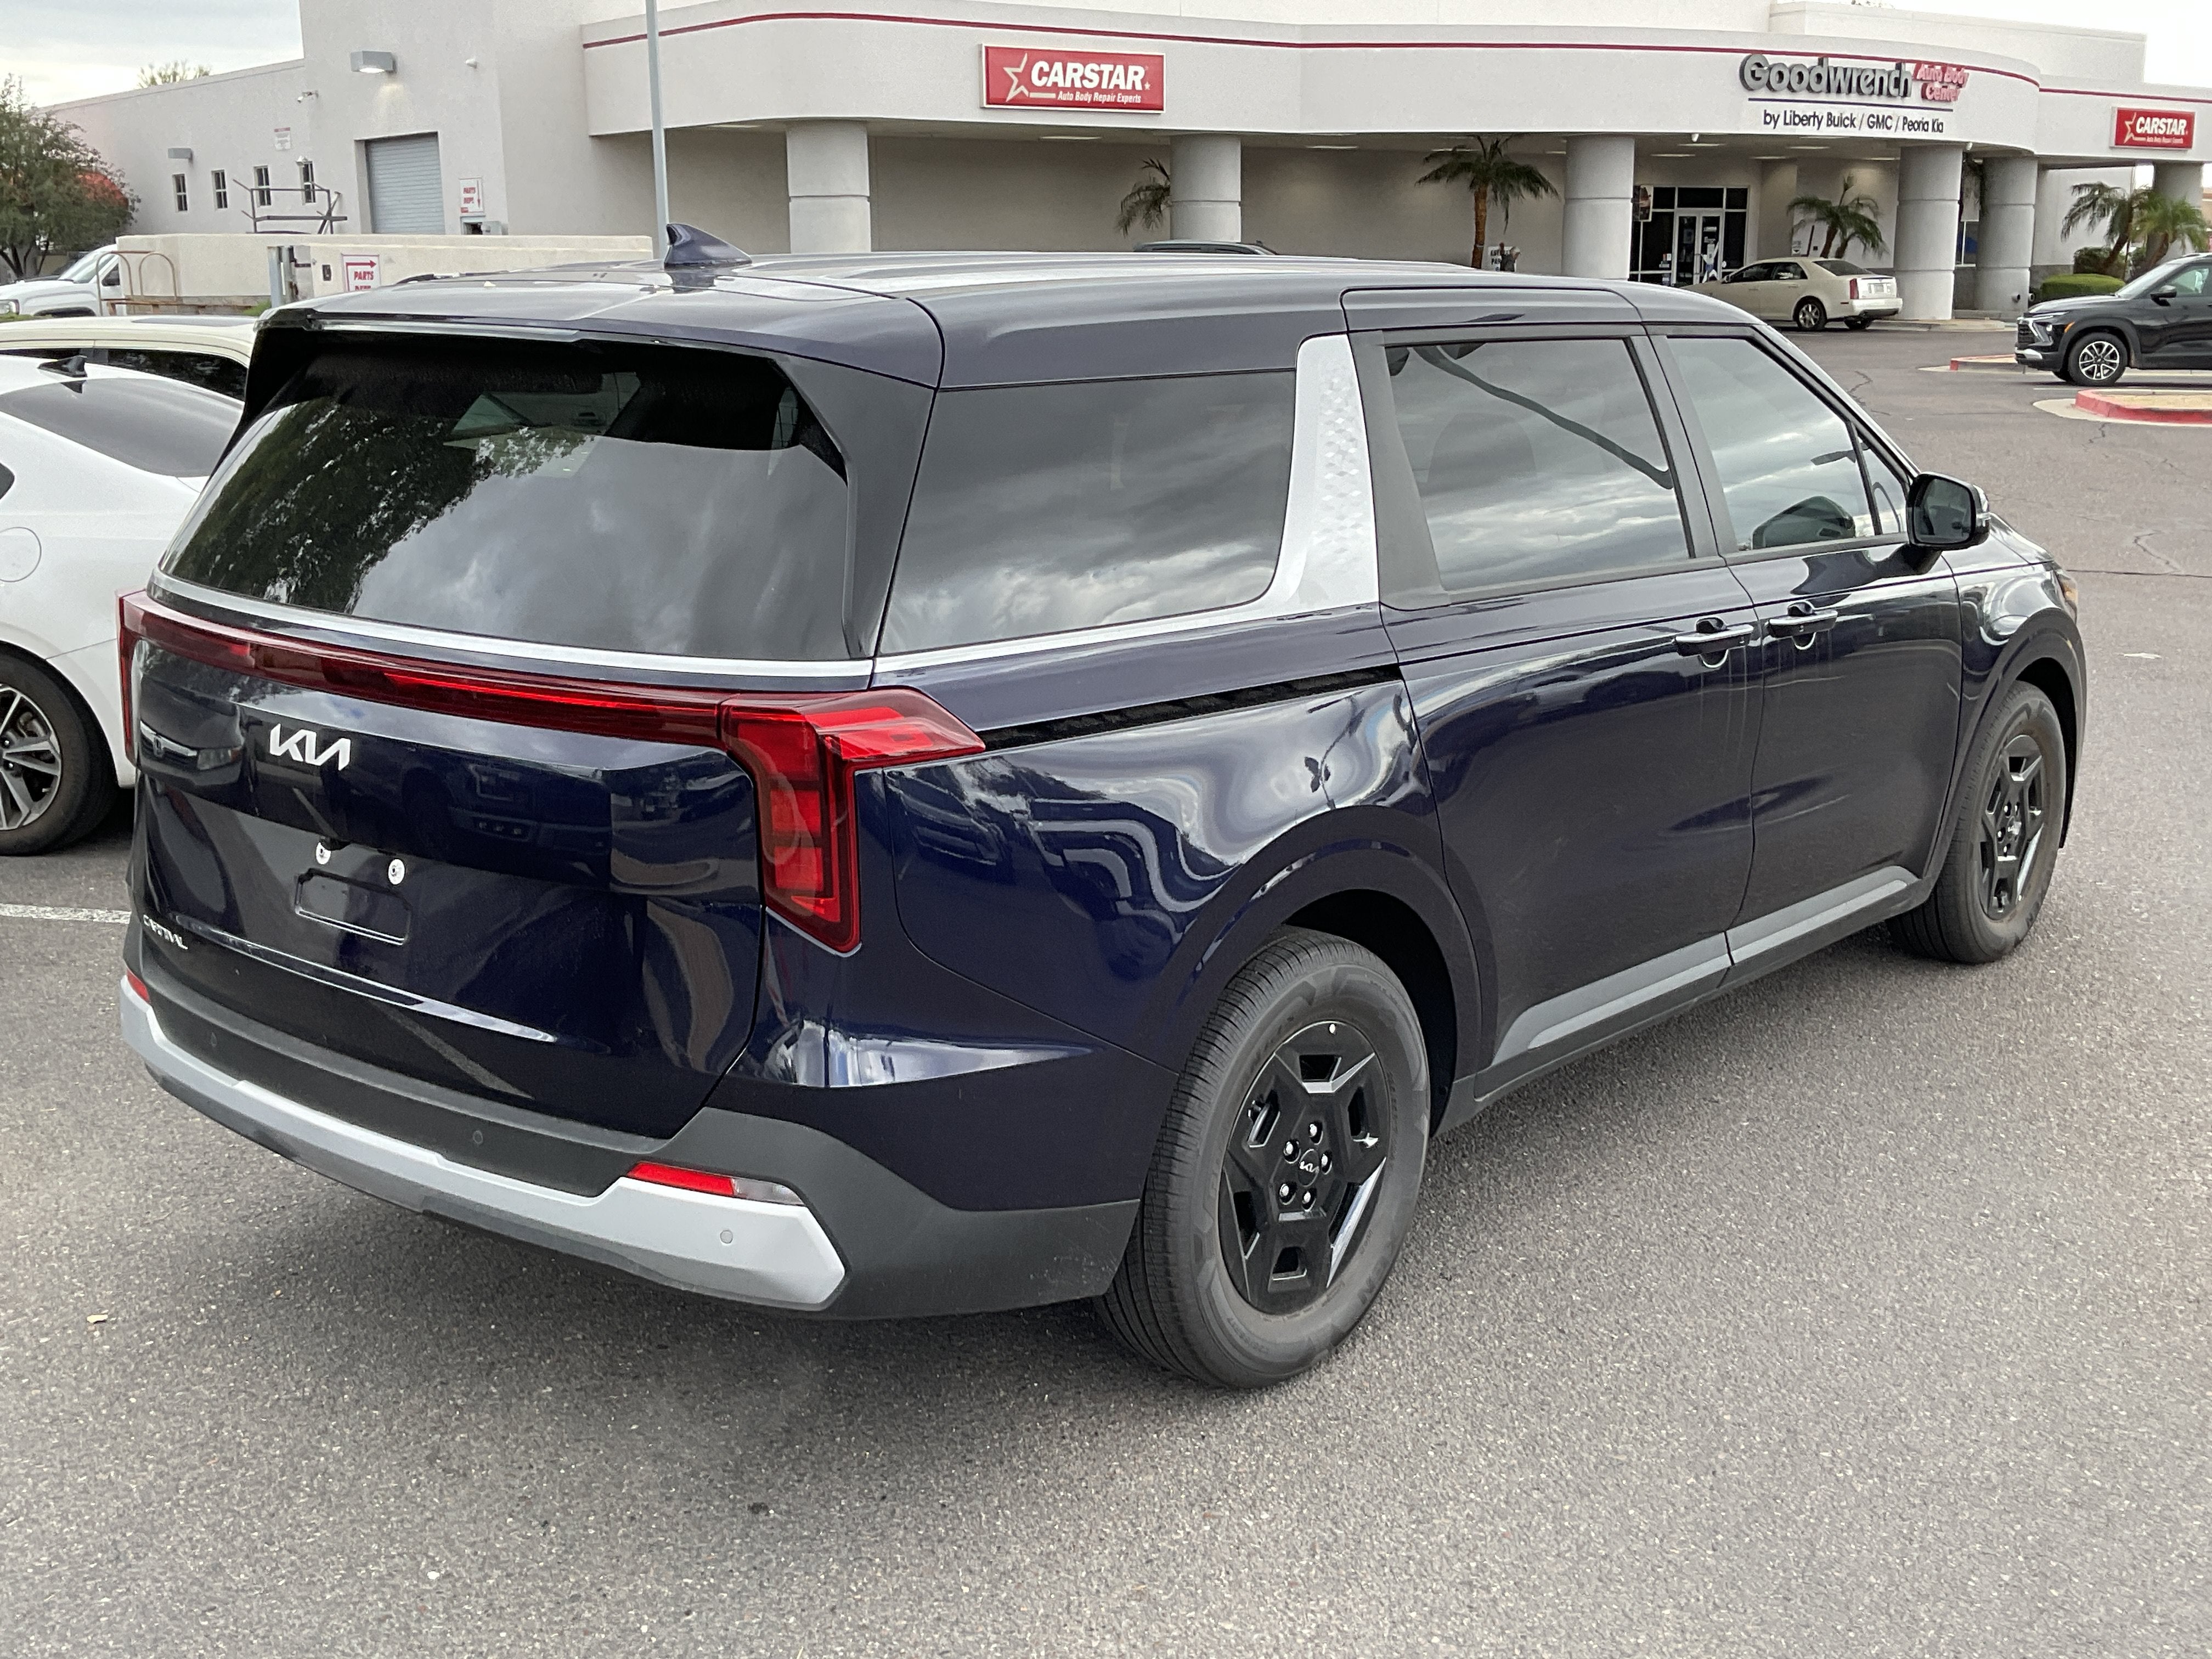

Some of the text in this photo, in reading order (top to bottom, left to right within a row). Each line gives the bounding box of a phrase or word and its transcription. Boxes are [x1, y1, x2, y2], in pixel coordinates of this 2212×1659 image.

[1031, 60, 1146, 91] CARSTAR
[1740, 53, 1912, 97] Goodwrench
[1915, 62, 1970, 88] Auto Body
[1057, 91, 1142, 105] Auto Body Repair Experts
[1921, 81, 1961, 102] Center
[1763, 109, 1944, 133] by Liberty Buick / GMC / Peoria Kia
[2136, 117, 2187, 135] CARSTAR
[354, 271, 374, 280] PARTS
[269, 723, 352, 771] KIA
